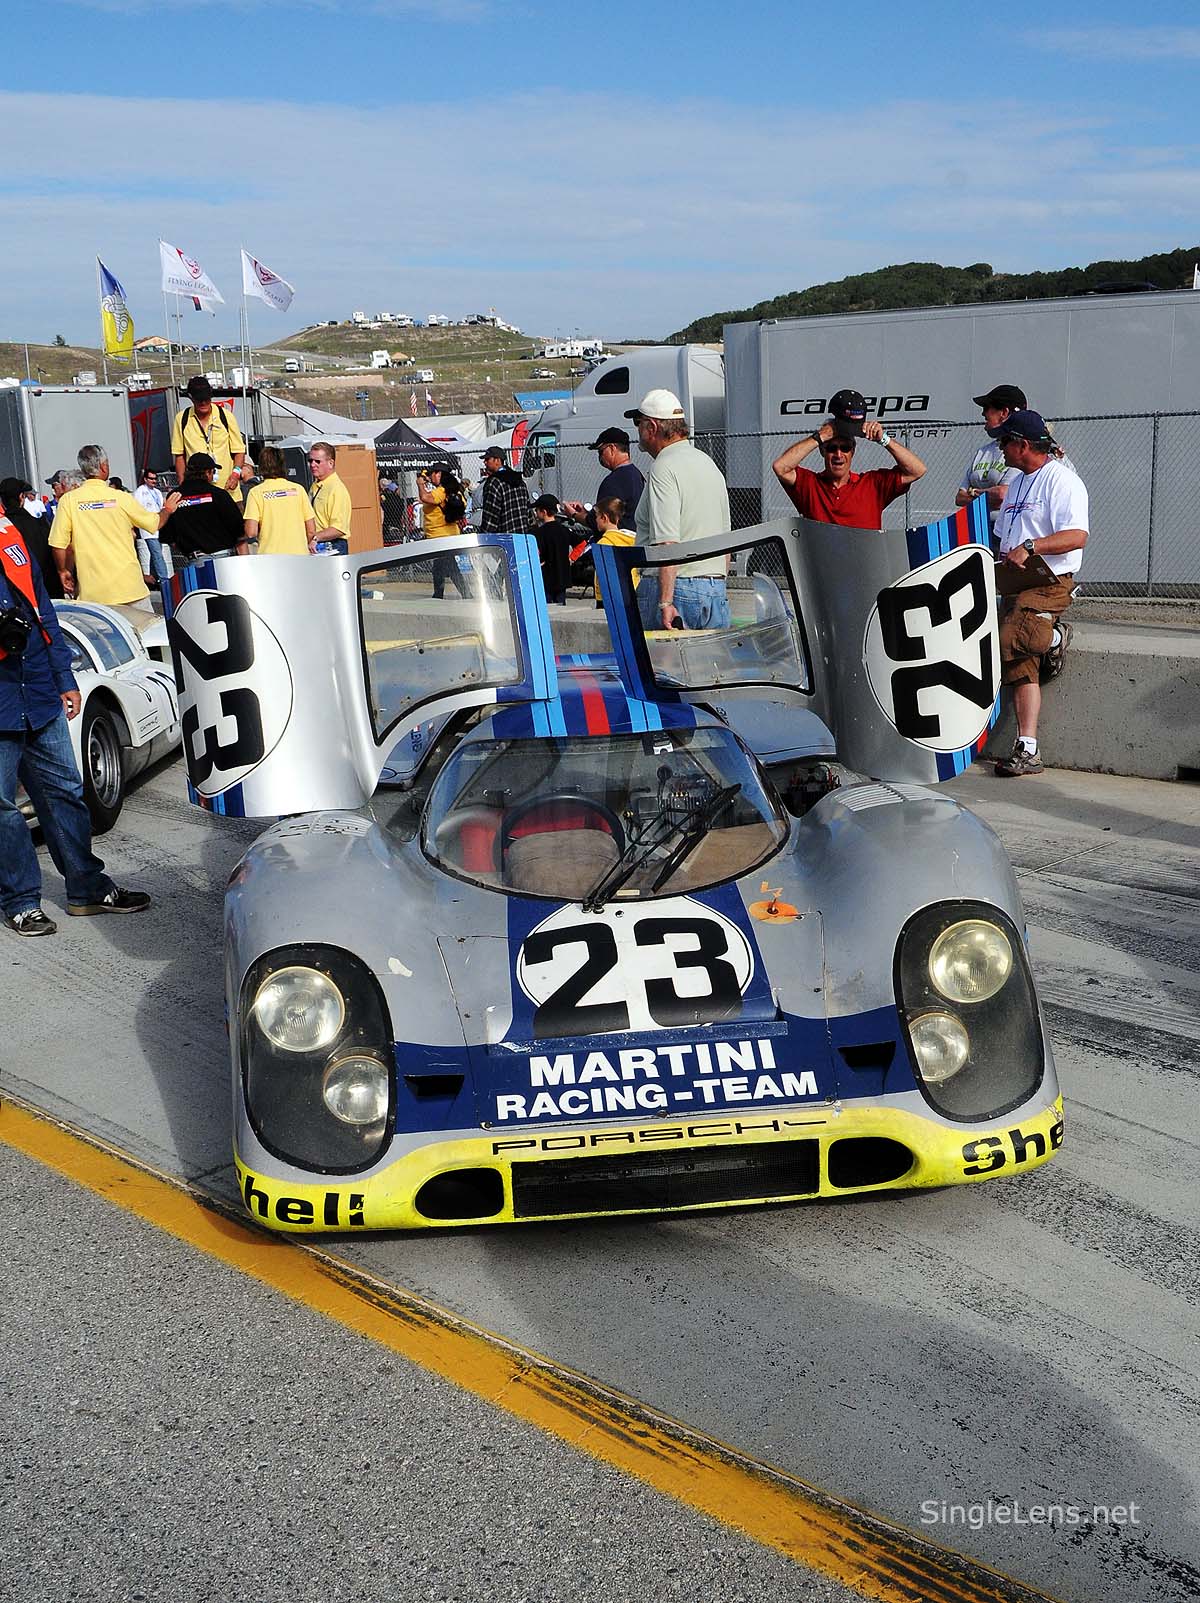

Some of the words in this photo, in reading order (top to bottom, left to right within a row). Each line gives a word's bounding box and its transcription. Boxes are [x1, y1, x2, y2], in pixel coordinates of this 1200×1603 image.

[167, 594, 265, 788] 23
[877, 552, 994, 738] 23
[523, 918, 743, 1040] 23
[530, 1039, 777, 1087] MARTINI
[236, 1167, 365, 1226] hell
